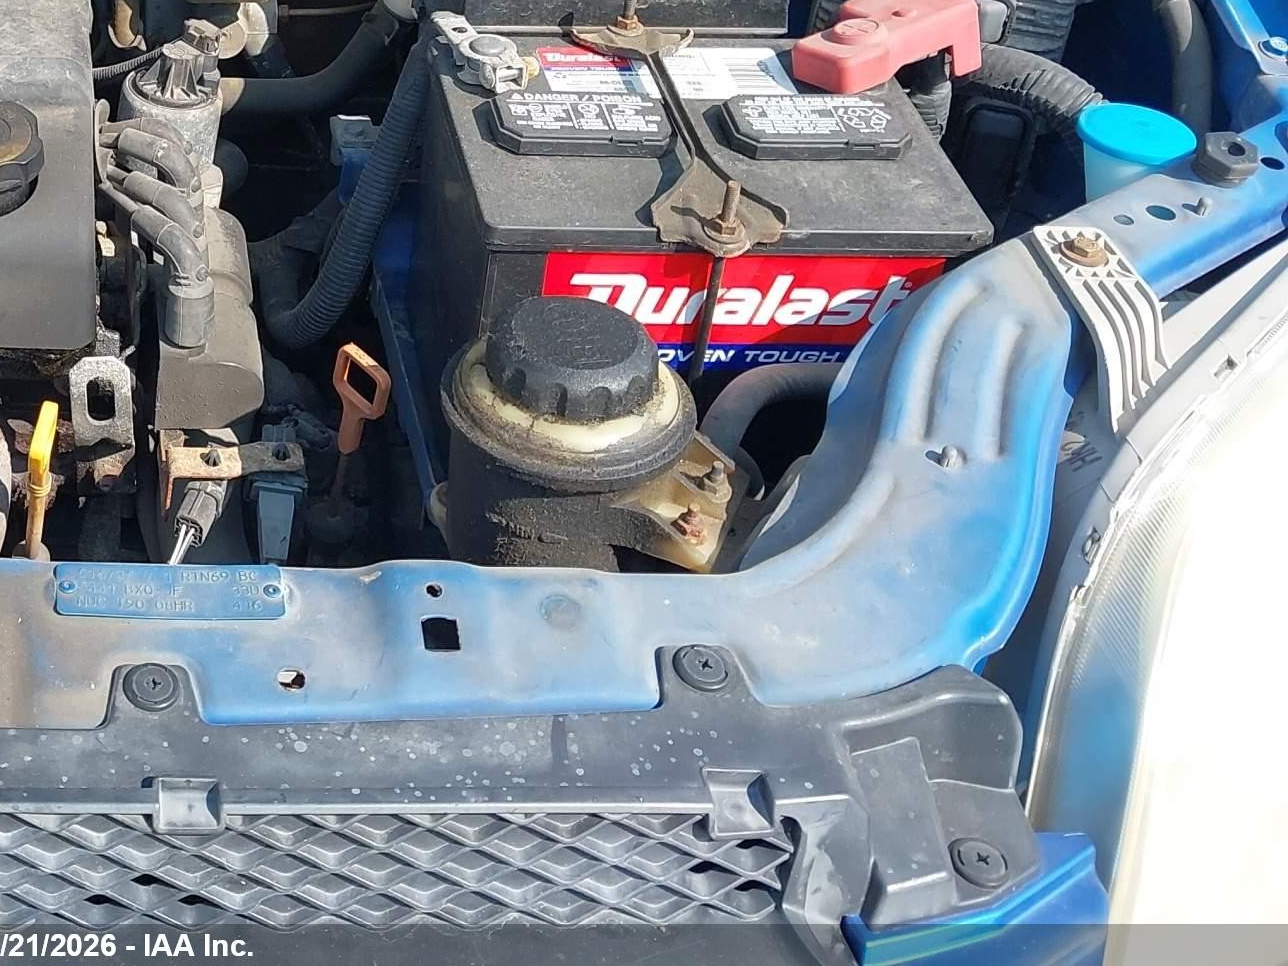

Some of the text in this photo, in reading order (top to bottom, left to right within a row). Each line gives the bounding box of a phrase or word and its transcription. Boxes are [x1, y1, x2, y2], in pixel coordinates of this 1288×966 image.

[524, 93, 579, 102] DANGER
[570, 274, 911, 326] Duralast
[657, 348, 842, 363] OVEN TOUGH
